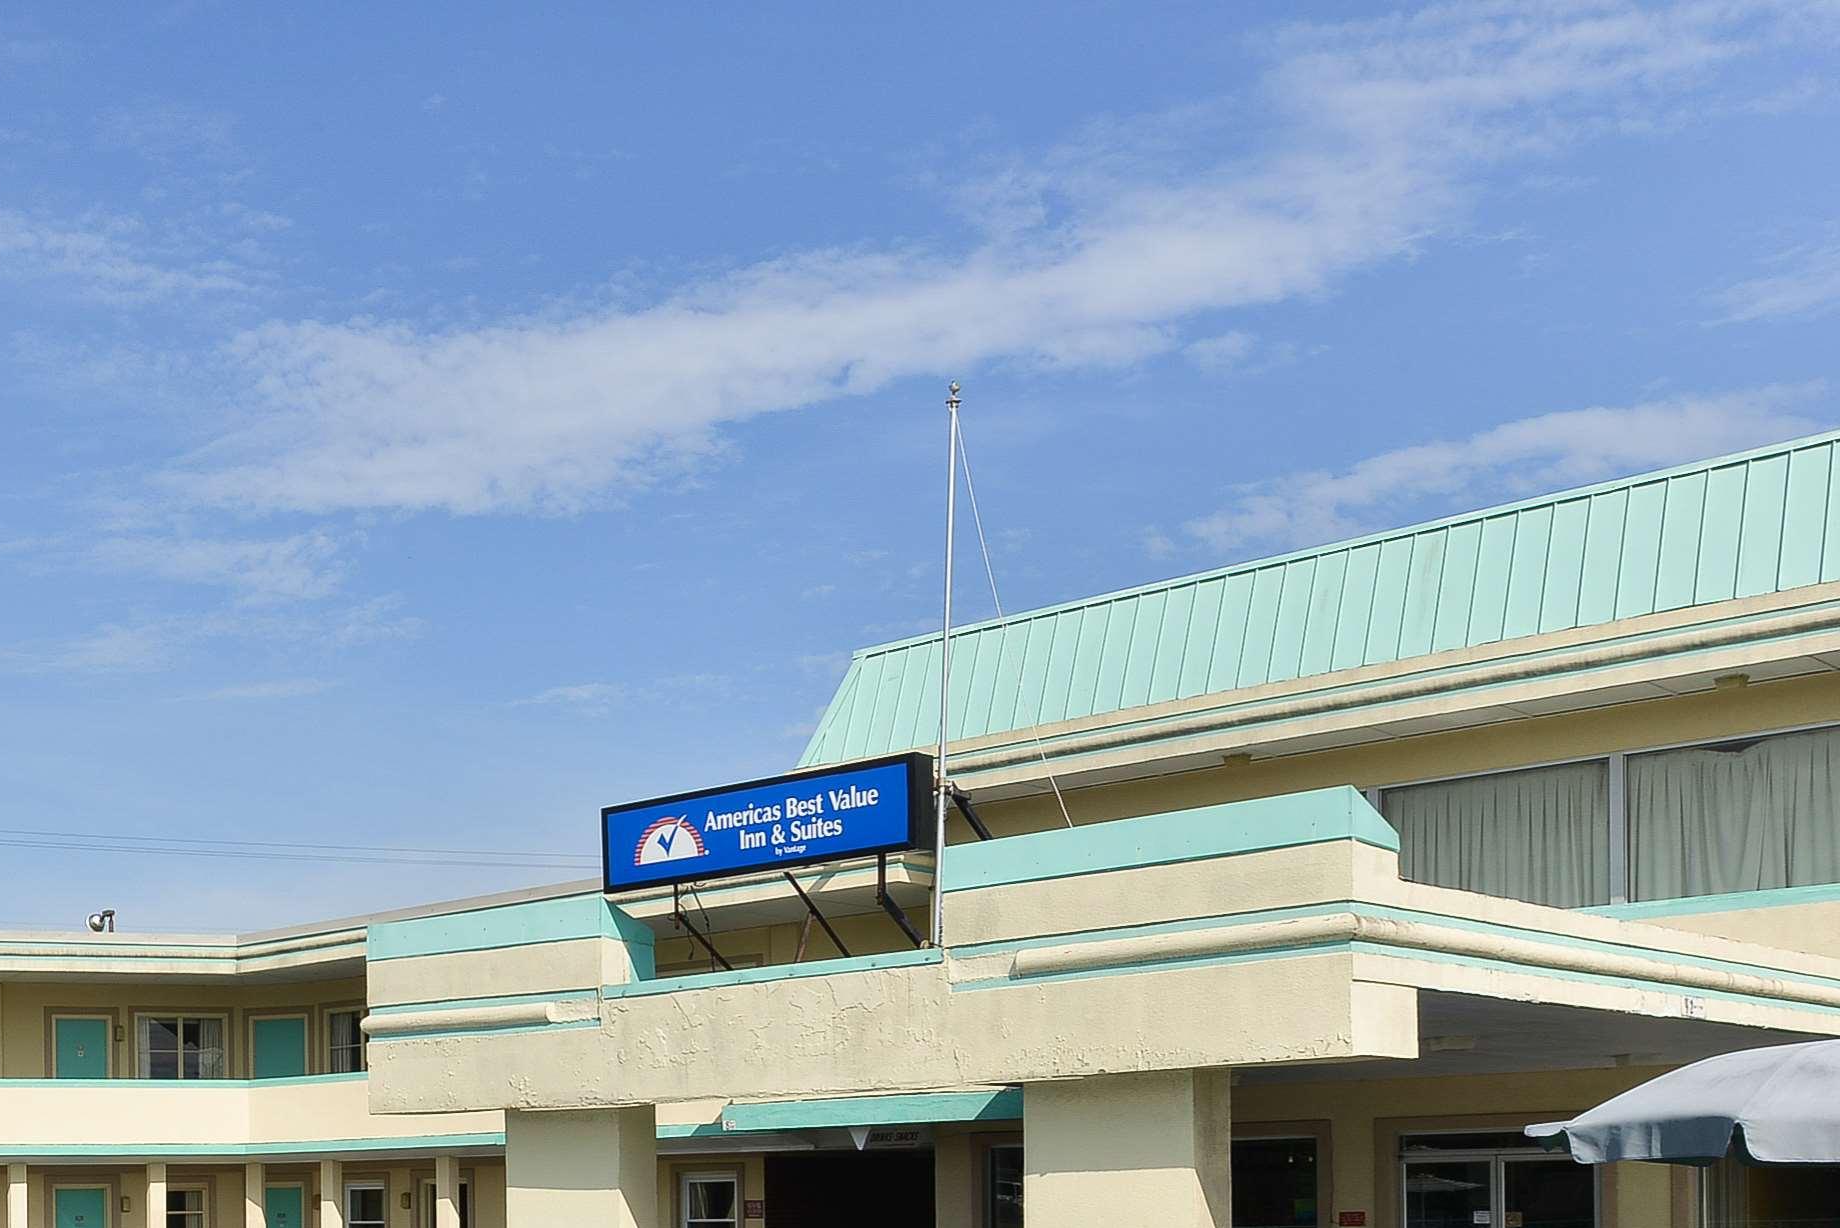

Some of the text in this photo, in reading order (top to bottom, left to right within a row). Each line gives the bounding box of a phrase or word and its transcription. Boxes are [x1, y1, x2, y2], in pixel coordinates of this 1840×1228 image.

[704, 785, 879, 832] Americas Best Value
[739, 817, 843, 850] Inn & Suites
[775, 847, 783, 857] by
